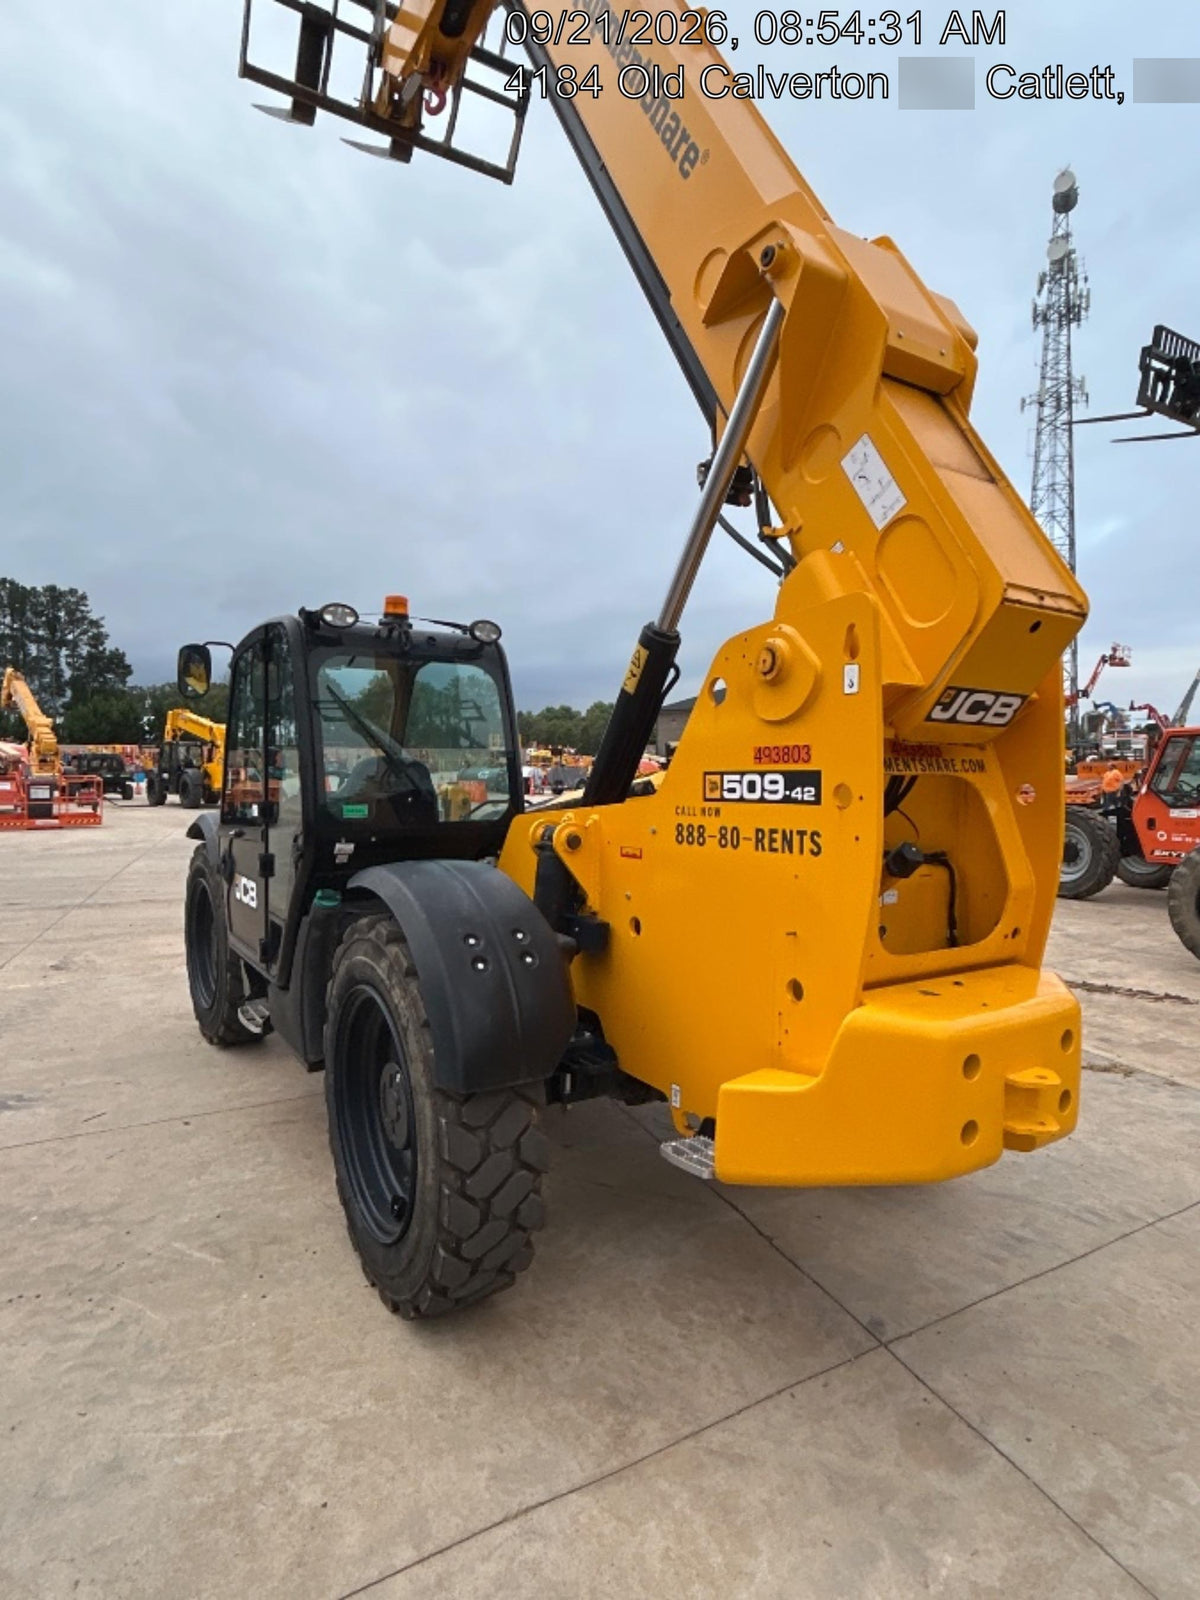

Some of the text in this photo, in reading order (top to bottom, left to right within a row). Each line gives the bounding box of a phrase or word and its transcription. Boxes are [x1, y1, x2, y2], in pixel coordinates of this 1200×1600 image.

[931, 691, 1022, 724] JCB
[754, 745, 811, 764] 493803
[675, 805, 721, 817] CALL NOW
[675, 823, 822, 857] 888-80-RENTS
